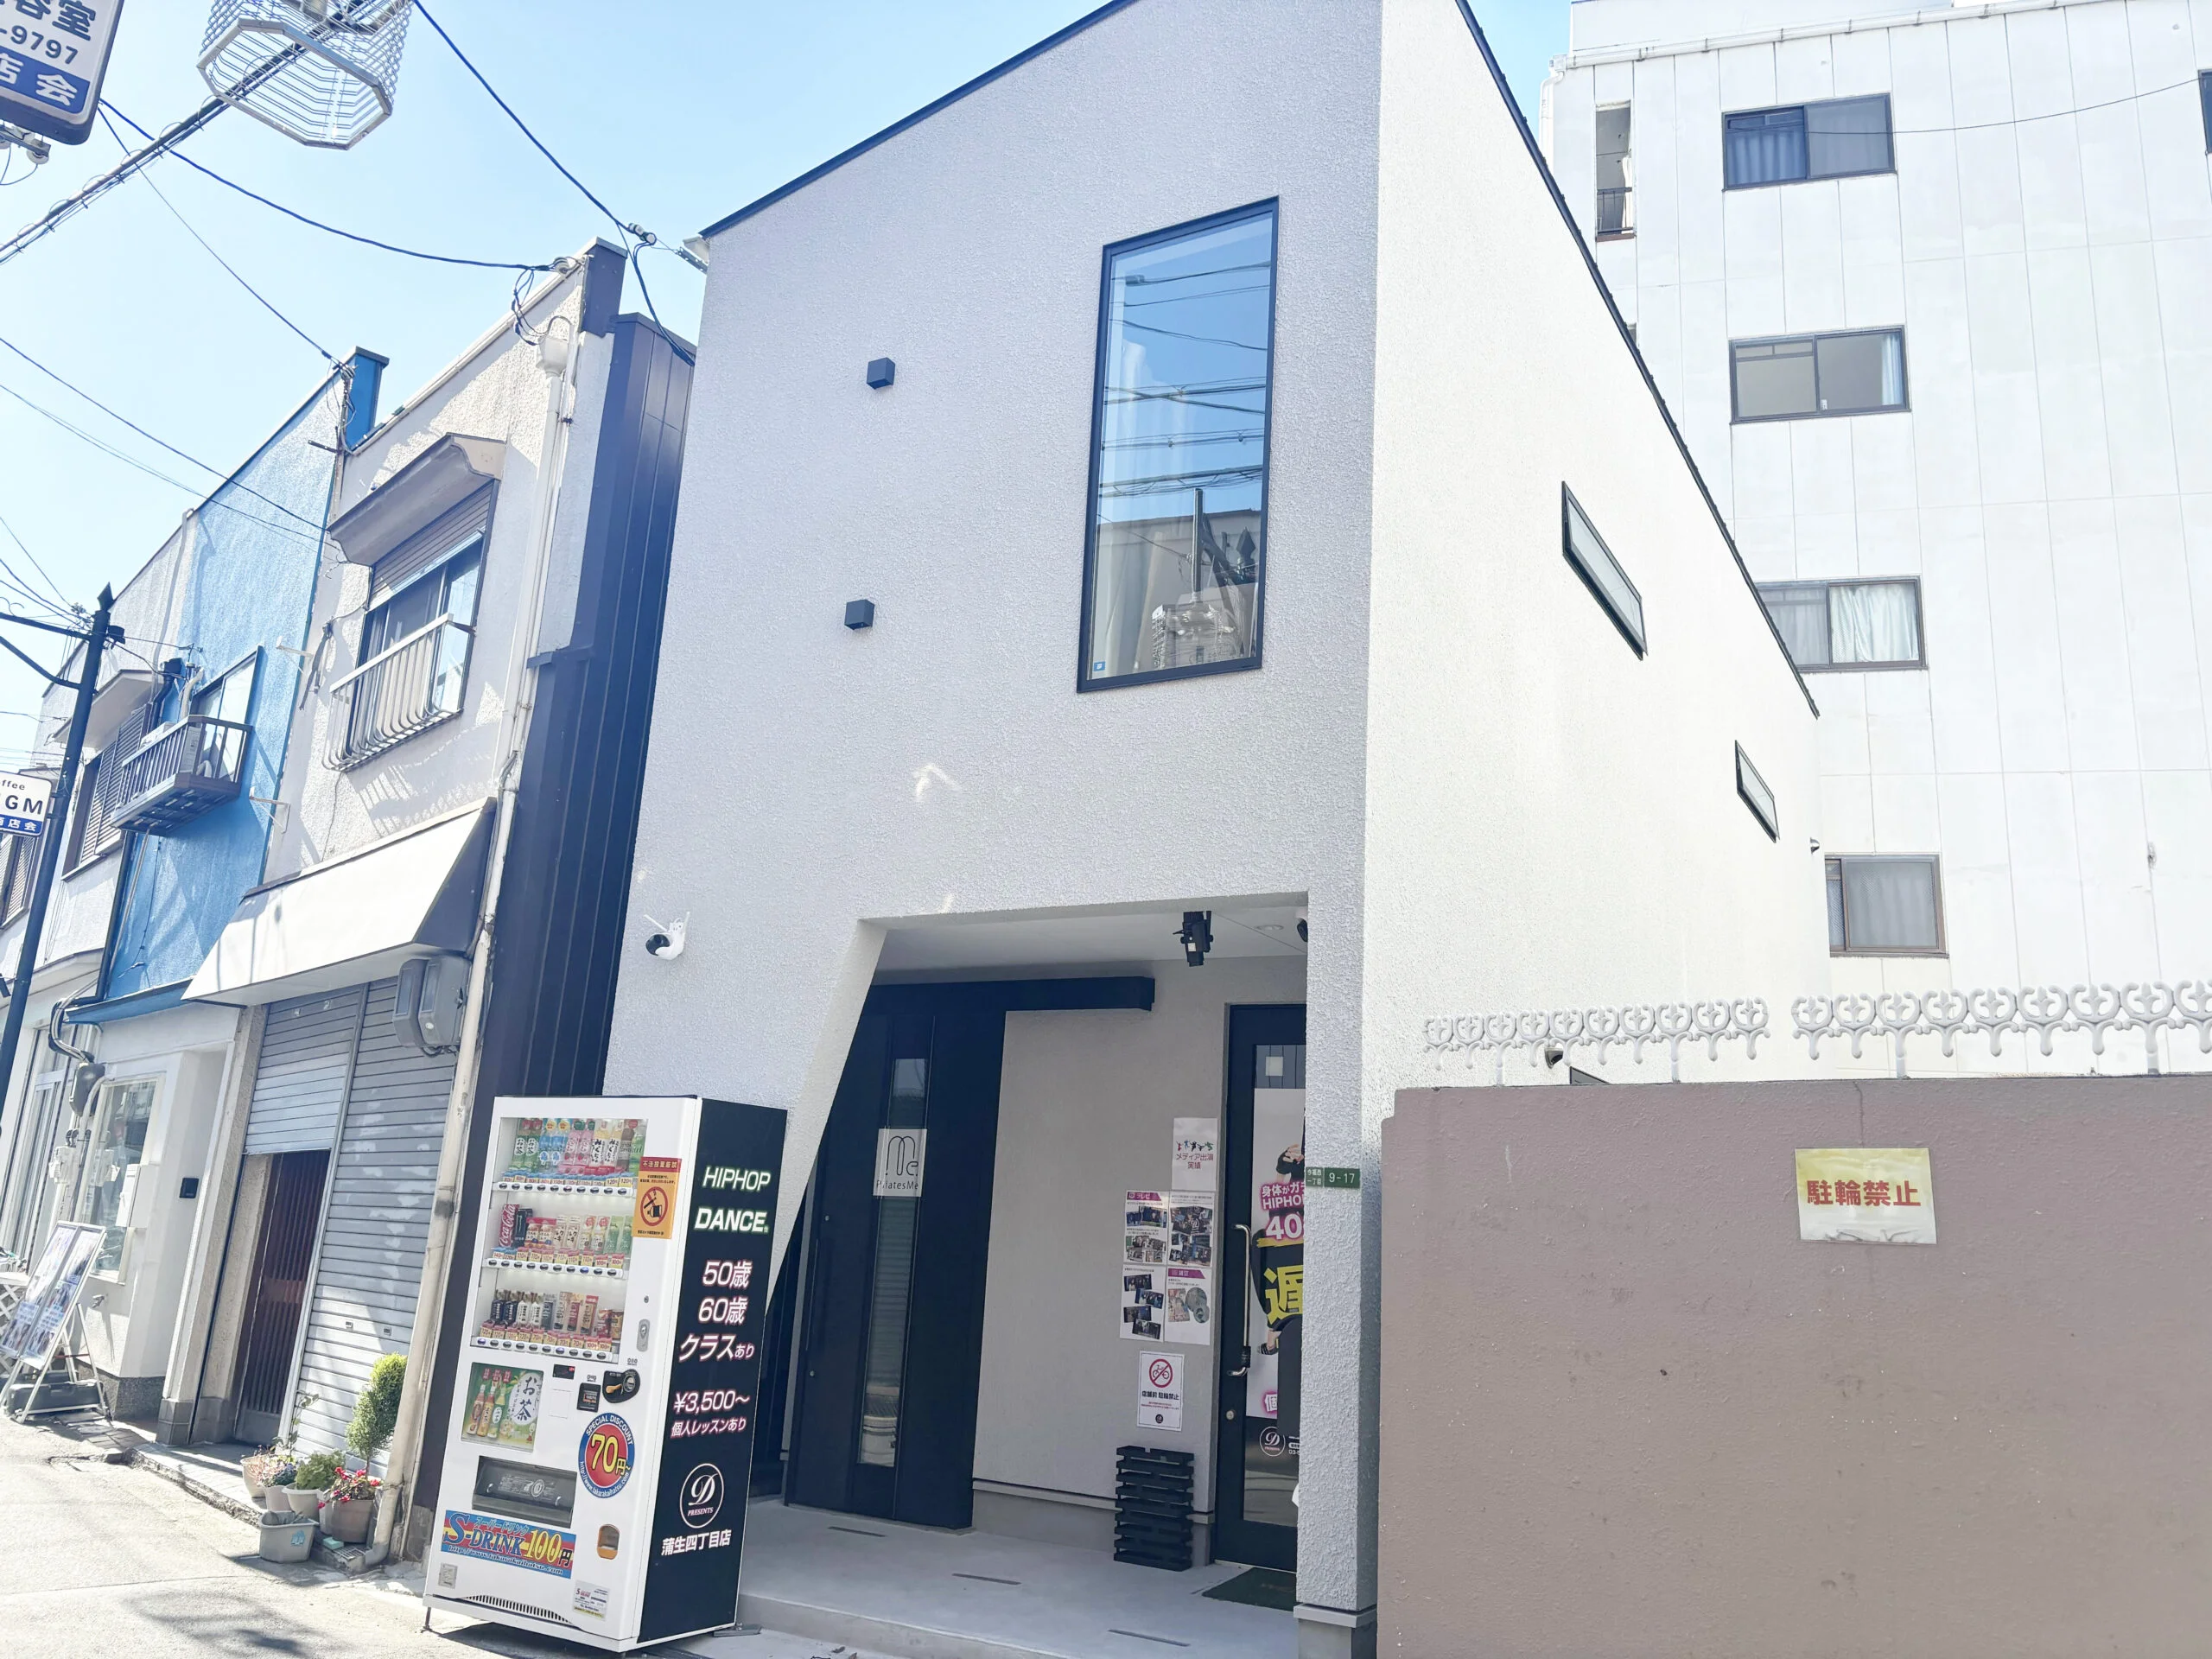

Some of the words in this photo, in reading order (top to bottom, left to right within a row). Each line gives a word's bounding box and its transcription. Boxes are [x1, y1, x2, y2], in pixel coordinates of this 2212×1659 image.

[702, 1165, 772, 1192] HIPHOP
[1329, 1173, 1355, 1184] 9-17
[1262, 1194, 1305, 1210] HIPHO
[1806, 1179, 1922, 1207] 駐輪禁止
[702, 1260, 753, 1289] 50歳
[697, 1296, 748, 1325] 60歳
[515, 1376, 537, 1421] お茶
[586, 1414, 609, 1436] SPECIAL
[610, 1414, 634, 1446] DISCOUNT
[671, 1417, 747, 1438] 個人レッスンあり
[687, 1507, 714, 1517] PRESENTS
[442, 1512, 524, 1556] S-DRINK
[524, 1529, 574, 1567] 100円
[474, 1516, 530, 1536] スーパードリンク
[660, 1529, 732, 1556] 蒲生四丁目店
